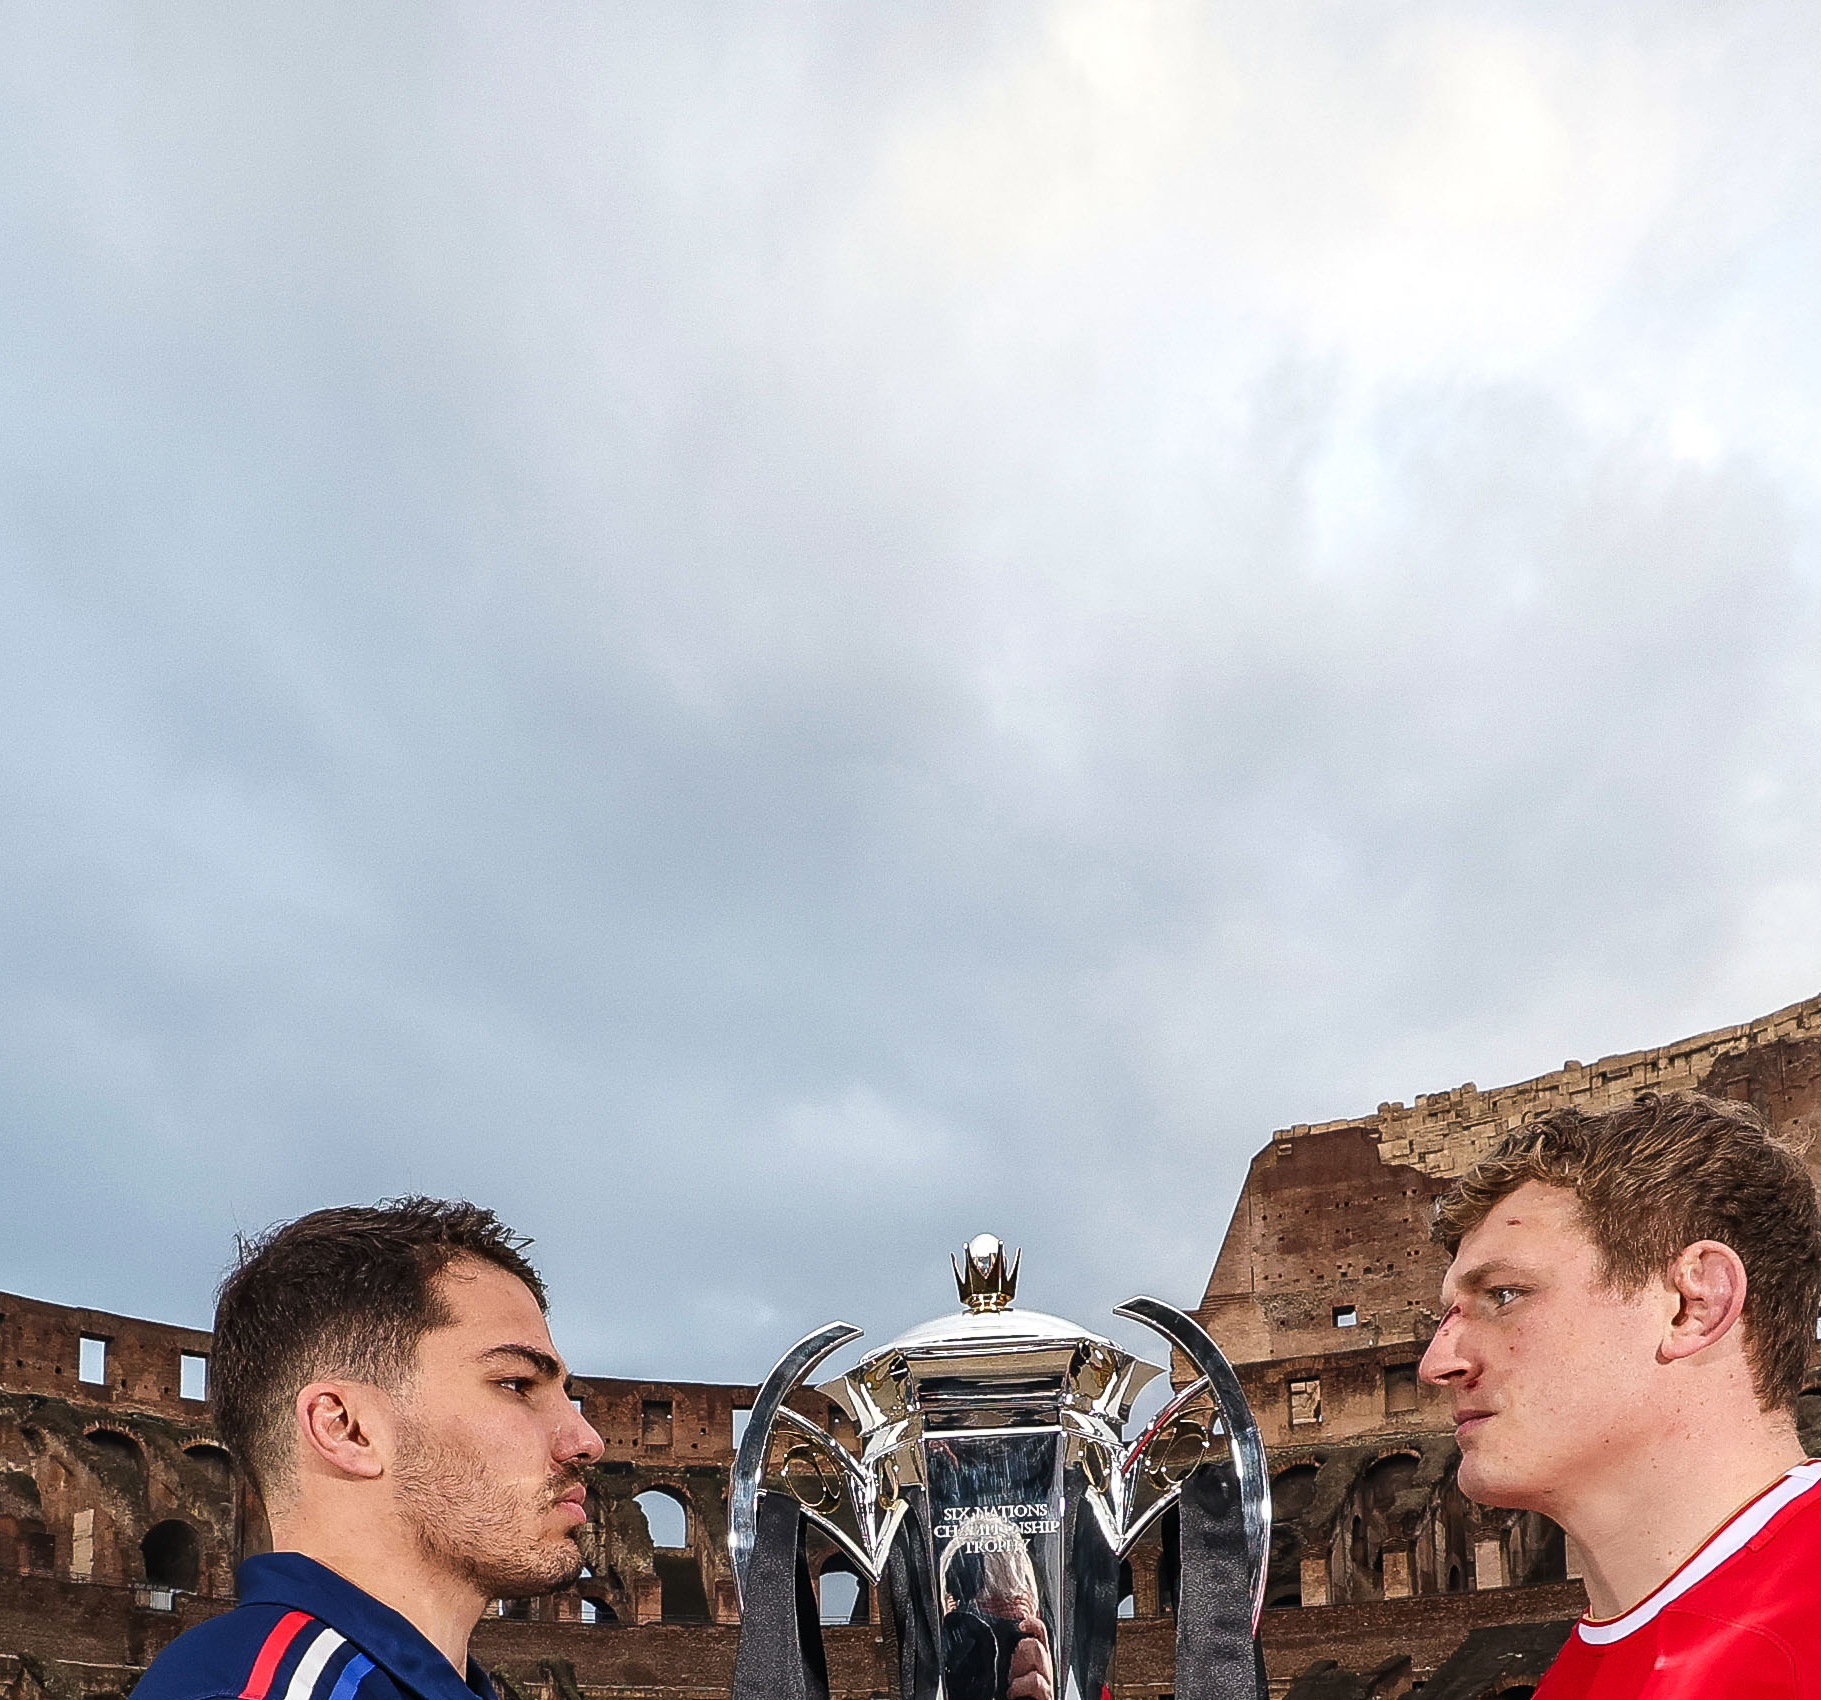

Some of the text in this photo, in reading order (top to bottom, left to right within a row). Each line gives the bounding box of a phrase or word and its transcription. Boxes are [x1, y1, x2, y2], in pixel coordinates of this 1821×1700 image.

[944, 1503, 1048, 1520] SIX NATIONS
[964, 1539, 1031, 1554] TROPHY
